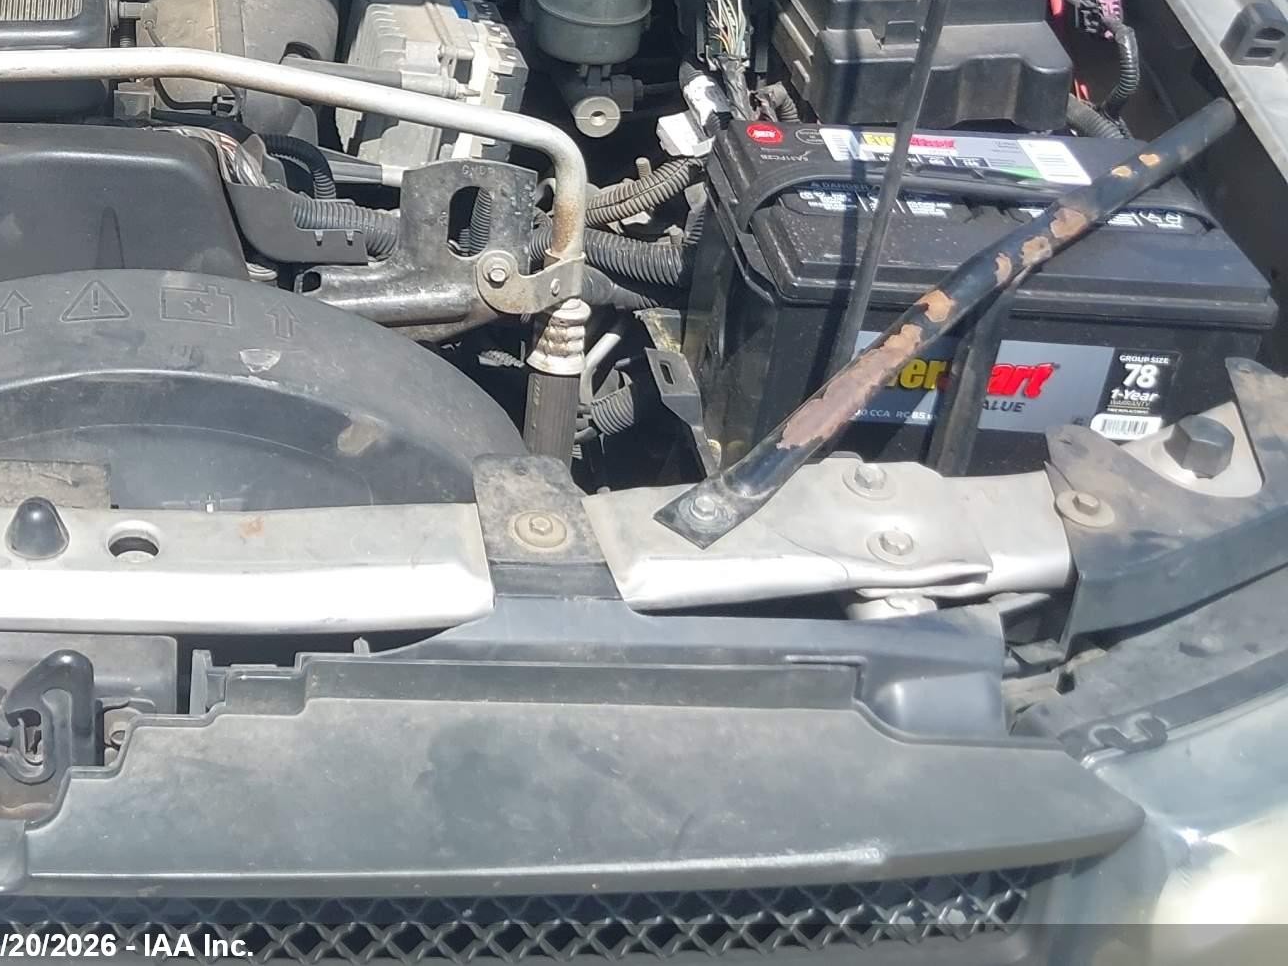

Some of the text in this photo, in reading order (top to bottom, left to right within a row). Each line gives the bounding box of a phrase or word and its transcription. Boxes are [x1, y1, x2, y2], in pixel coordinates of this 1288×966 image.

[1119, 355, 1169, 364] GROUP SIZE
[1122, 363, 1159, 388] 78
[1110, 388, 1160, 402] 1-Year
[982, 400, 1026, 413] ALUE
[869, 409, 890, 418] CCA
